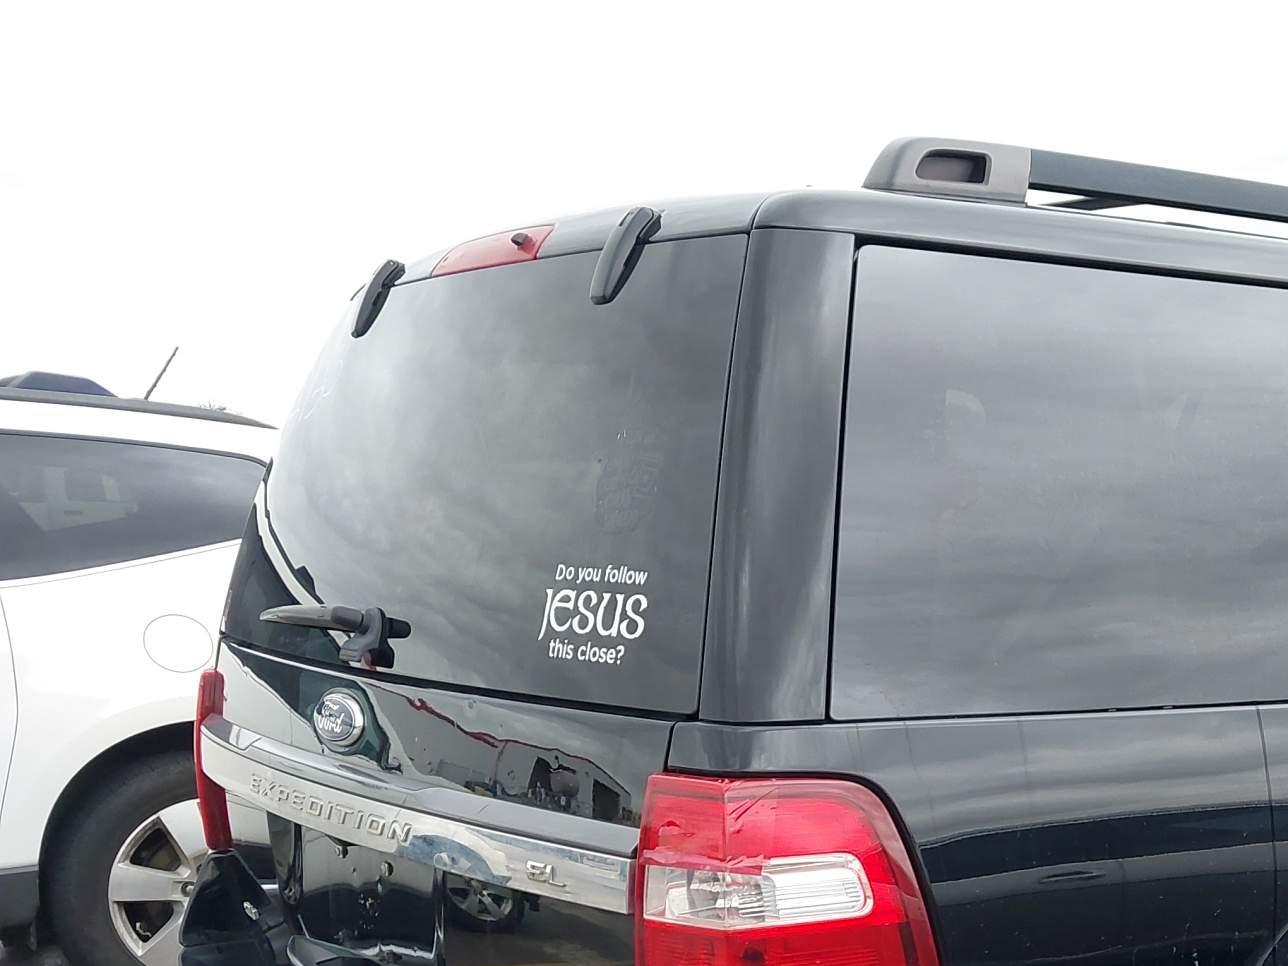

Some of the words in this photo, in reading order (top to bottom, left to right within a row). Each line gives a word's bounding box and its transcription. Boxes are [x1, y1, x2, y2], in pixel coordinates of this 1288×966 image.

[555, 563, 575, 581] Do
[576, 567, 602, 584] you
[604, 564, 648, 585] follow
[548, 638, 574, 660] this
[577, 641, 625, 665] close?
[249, 773, 413, 846] EXPEDITION
